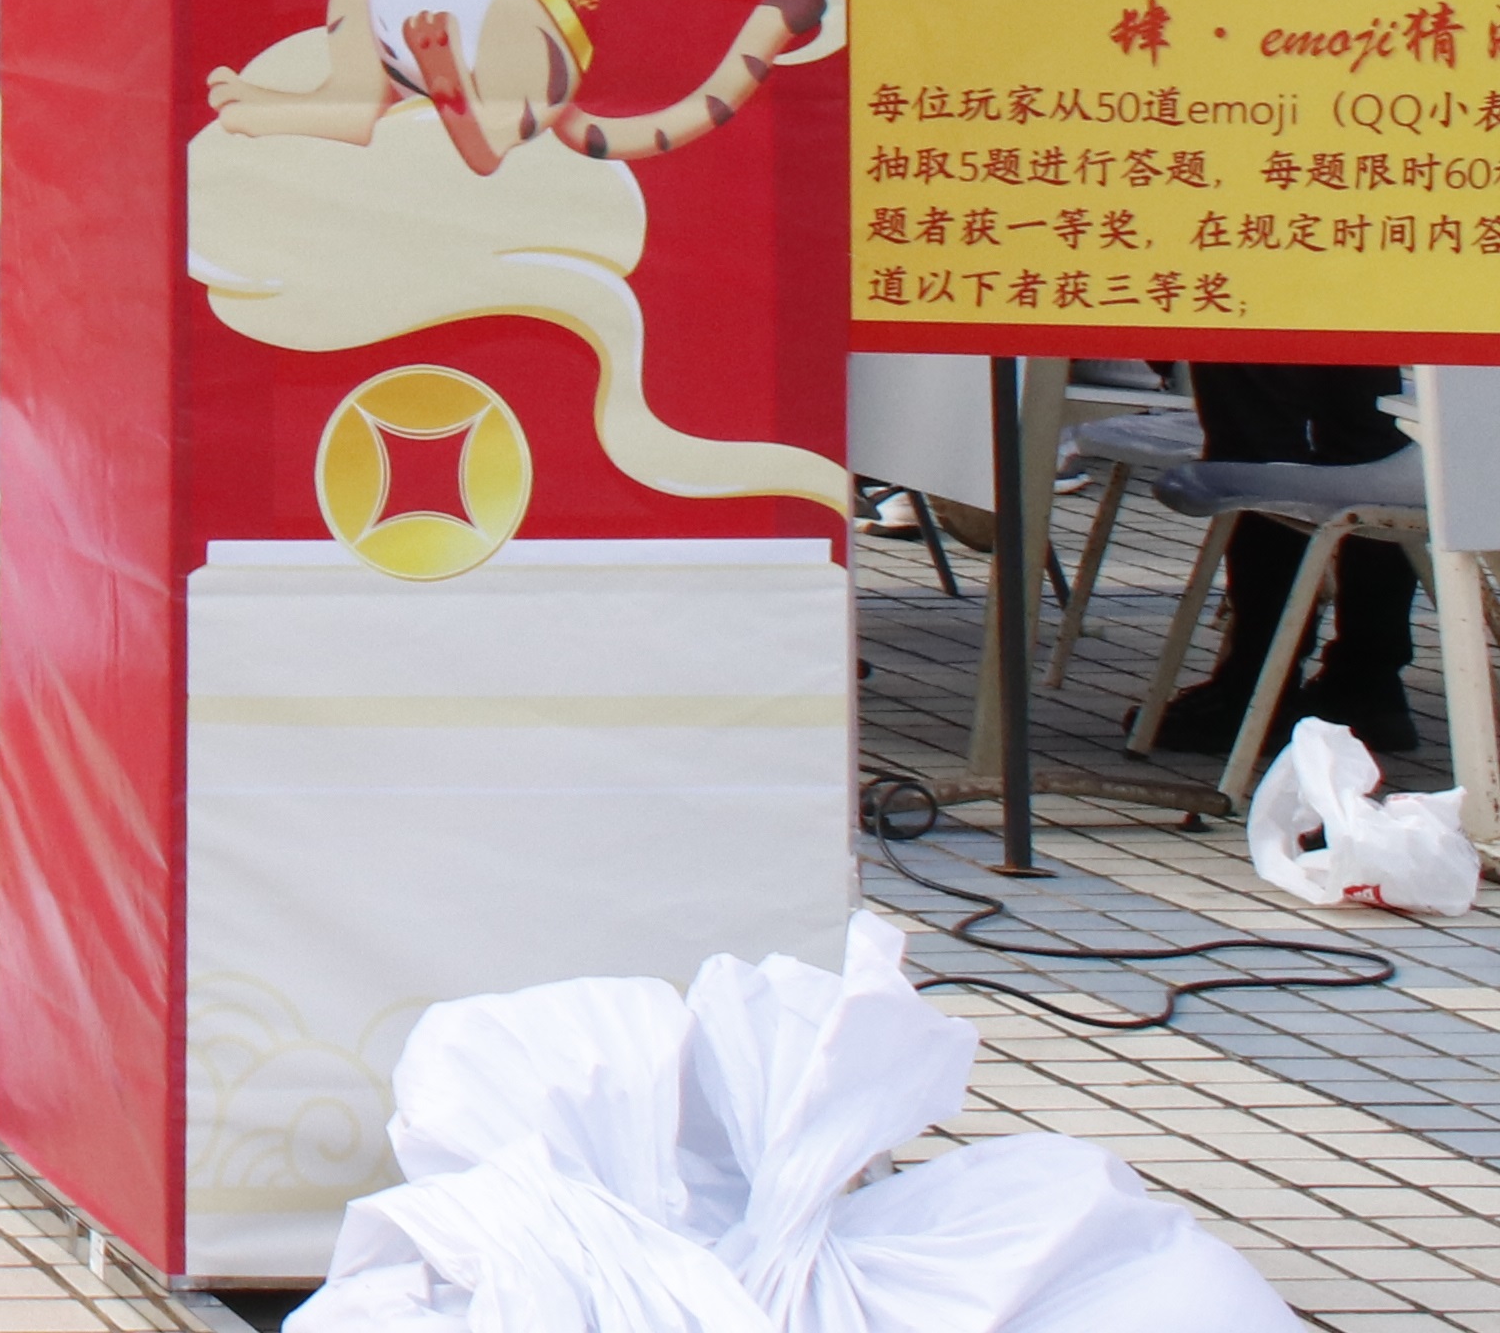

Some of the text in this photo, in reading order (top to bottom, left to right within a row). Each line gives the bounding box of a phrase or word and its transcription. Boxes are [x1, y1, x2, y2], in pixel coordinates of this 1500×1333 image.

[866, 144, 1500, 192] 抽取5题进行答题，每题限时60
